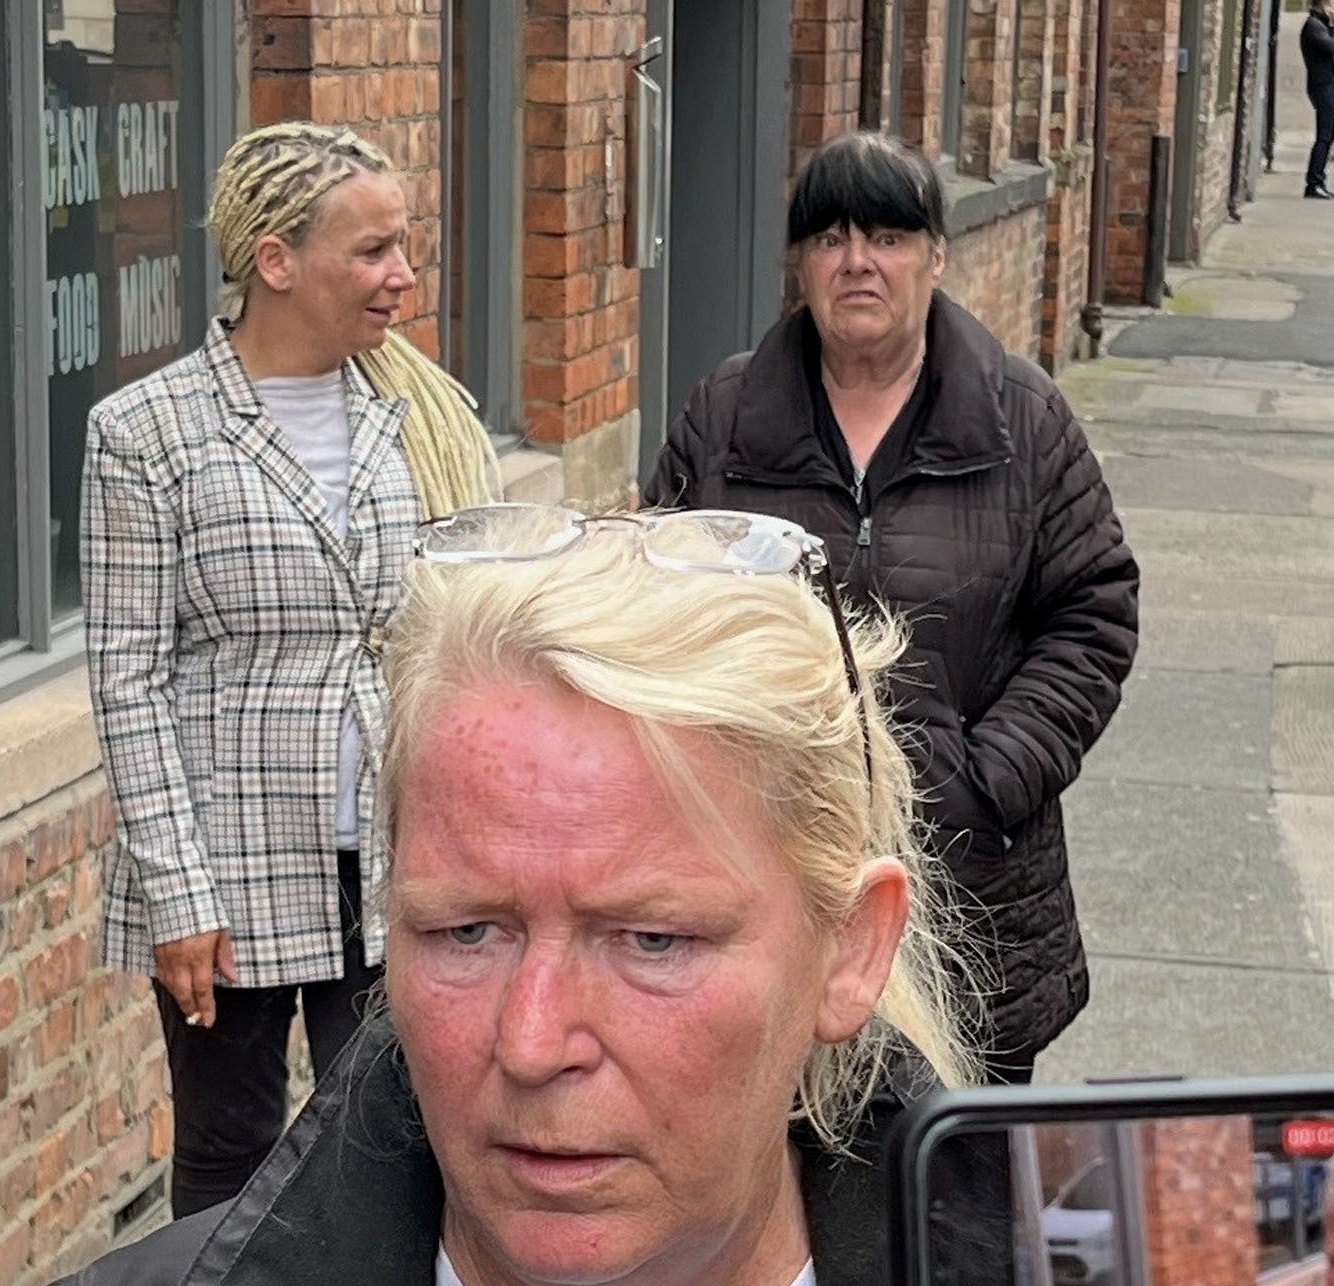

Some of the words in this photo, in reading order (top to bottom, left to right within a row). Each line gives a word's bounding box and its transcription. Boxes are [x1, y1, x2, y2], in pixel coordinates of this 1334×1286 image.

[43, 105, 101, 210] CASK
[118, 100, 179, 199] CRAFT
[46, 272, 100, 377] FOOD
[119, 254, 181, 358] MUSIC
